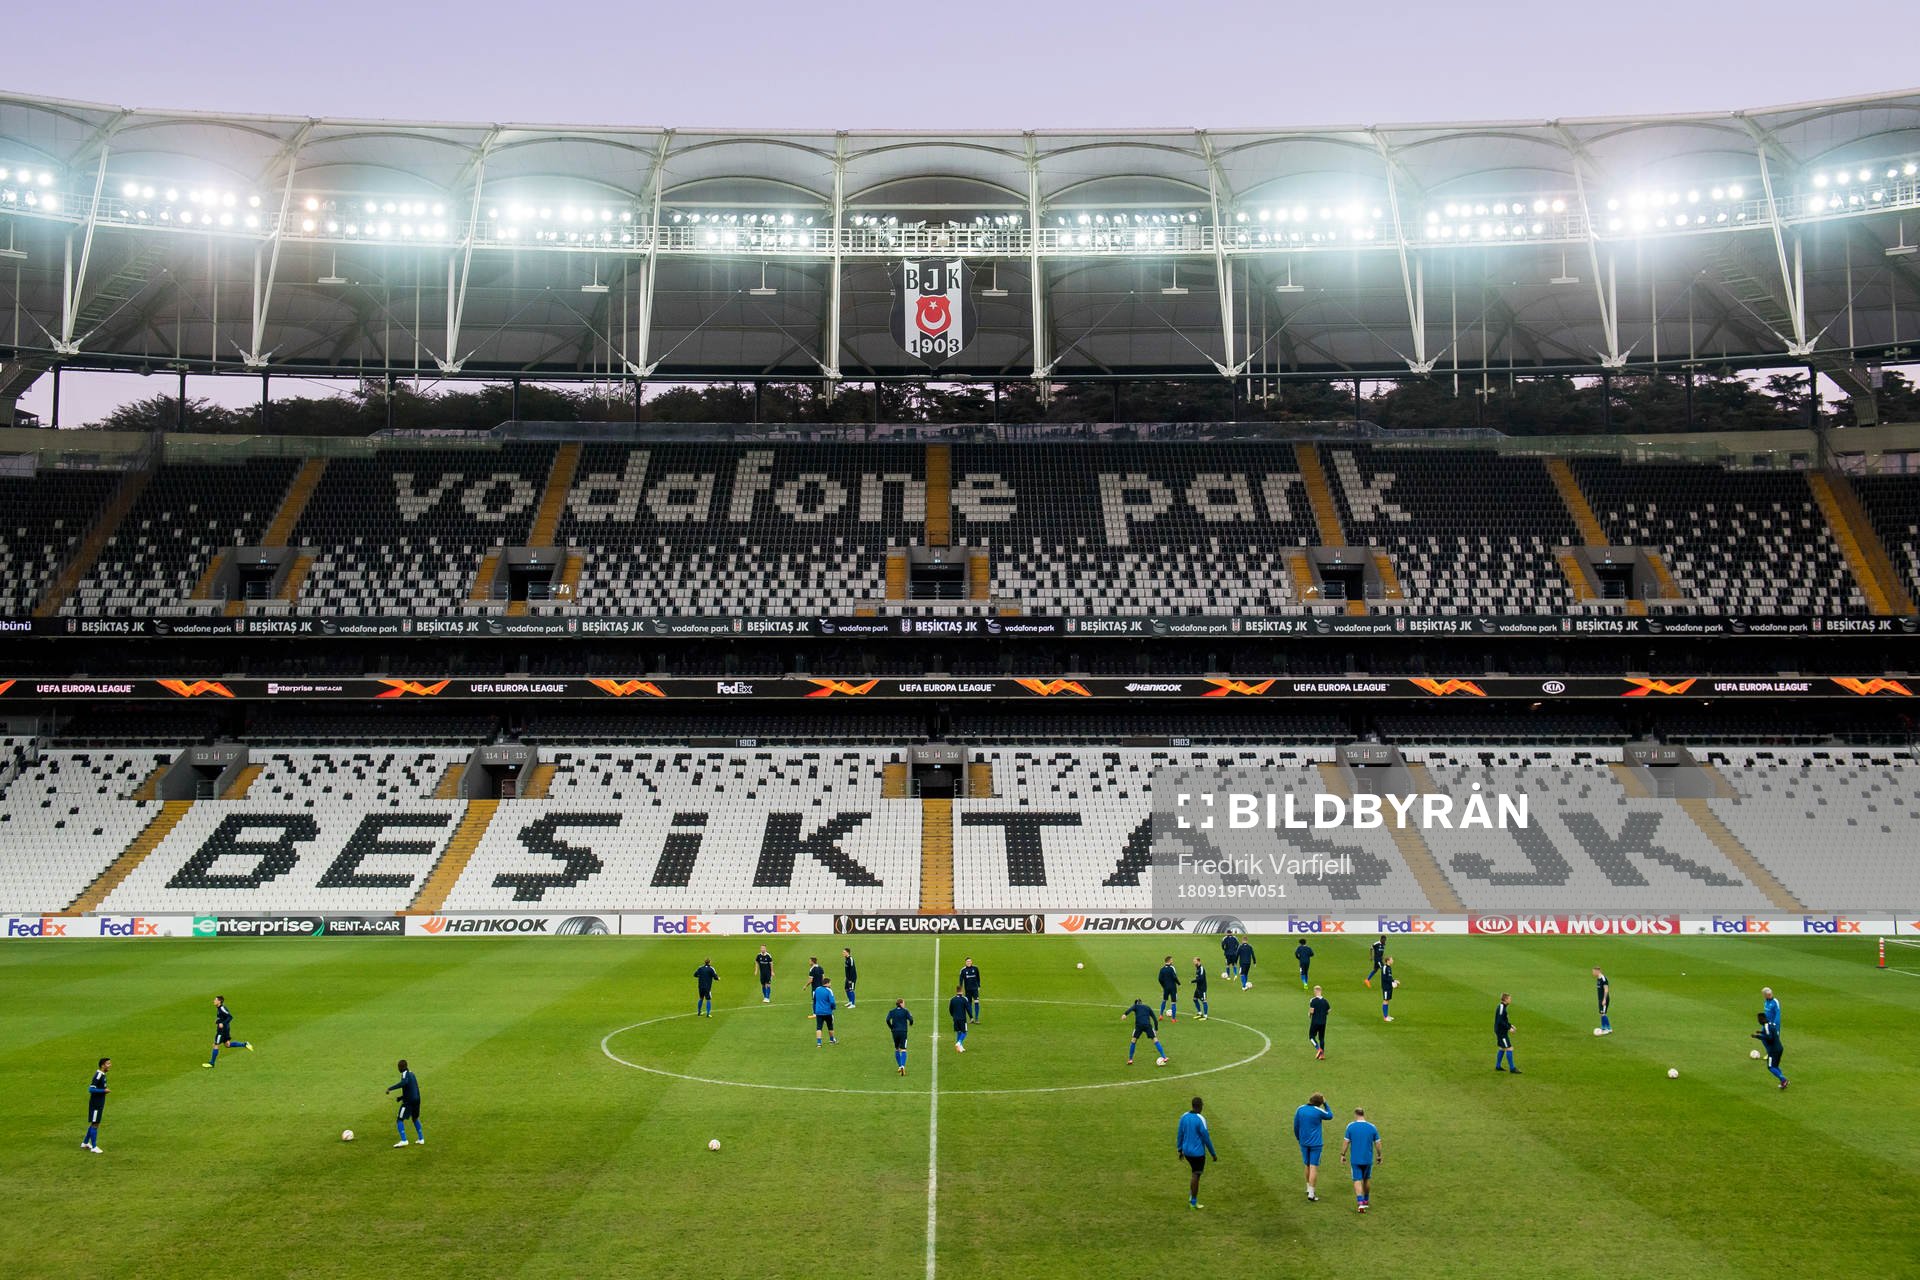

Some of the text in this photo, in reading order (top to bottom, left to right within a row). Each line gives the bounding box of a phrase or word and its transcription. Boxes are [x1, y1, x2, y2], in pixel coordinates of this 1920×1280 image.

[910, 339, 960, 353] 1903
[392, 450, 1412, 546] vodafone park
[132, 622, 144, 631] JK
[300, 622, 312, 631] JK
[340, 625, 397, 634] vodafone park
[467, 622, 478, 631] JK
[507, 625, 563, 634] vodafone park
[632, 622, 643, 631] JK
[672, 625, 729, 634] vodafone park
[796, 622, 808, 631] JK
[872, 625, 889, 634] park
[965, 622, 977, 631] JK
[1037, 625, 1055, 634] park
[1130, 621, 1142, 630] JK
[1170, 624, 1228, 634] vodafone park
[1295, 622, 1307, 631] JK
[1334, 624, 1391, 633] vodafone park
[1460, 621, 1472, 630] JK
[1500, 624, 1557, 633] vodafone park
[1626, 621, 1638, 630] JK
[1665, 624, 1724, 633] vodafone park
[1750, 624, 1808, 633] vodafone park
[1879, 620, 1891, 630] JK
[174, 625, 232, 635] vodafone park
[37, 685, 60, 693] UEFA
[62, 685, 95, 693] EUROPA
[471, 685, 493, 693] UEFA
[496, 685, 528, 693] EUROPA
[717, 682, 752, 694] FedEx
[900, 684, 922, 692] UEFA
[924, 684, 957, 692] EUROPA
[1294, 684, 1316, 692] UEFA
[1318, 684, 1351, 692] EUROPA
[1545, 684, 1562, 692] KIA
[1715, 683, 1738, 692] UEFA
[1739, 683, 1773, 692] EUROPA
[1449, 811, 1743, 887] JK
[8, 918, 66, 936] FedEx
[100, 918, 158, 936] FedEx
[200, 918, 400, 935] enterprise RENT-A-CAR
[653, 915, 711, 933] FedEx
[743, 915, 801, 933] FedEx
[855, 918, 1024, 931] UEFA EUROPA LEAGUE
[1287, 915, 1345, 933] FedEx
[1378, 915, 1435, 933] FedEx
[1483, 914, 1673, 934] KIA KIA MOTORS
[1713, 916, 1770, 933] FedEx
[1804, 916, 1860, 933] FedEx
